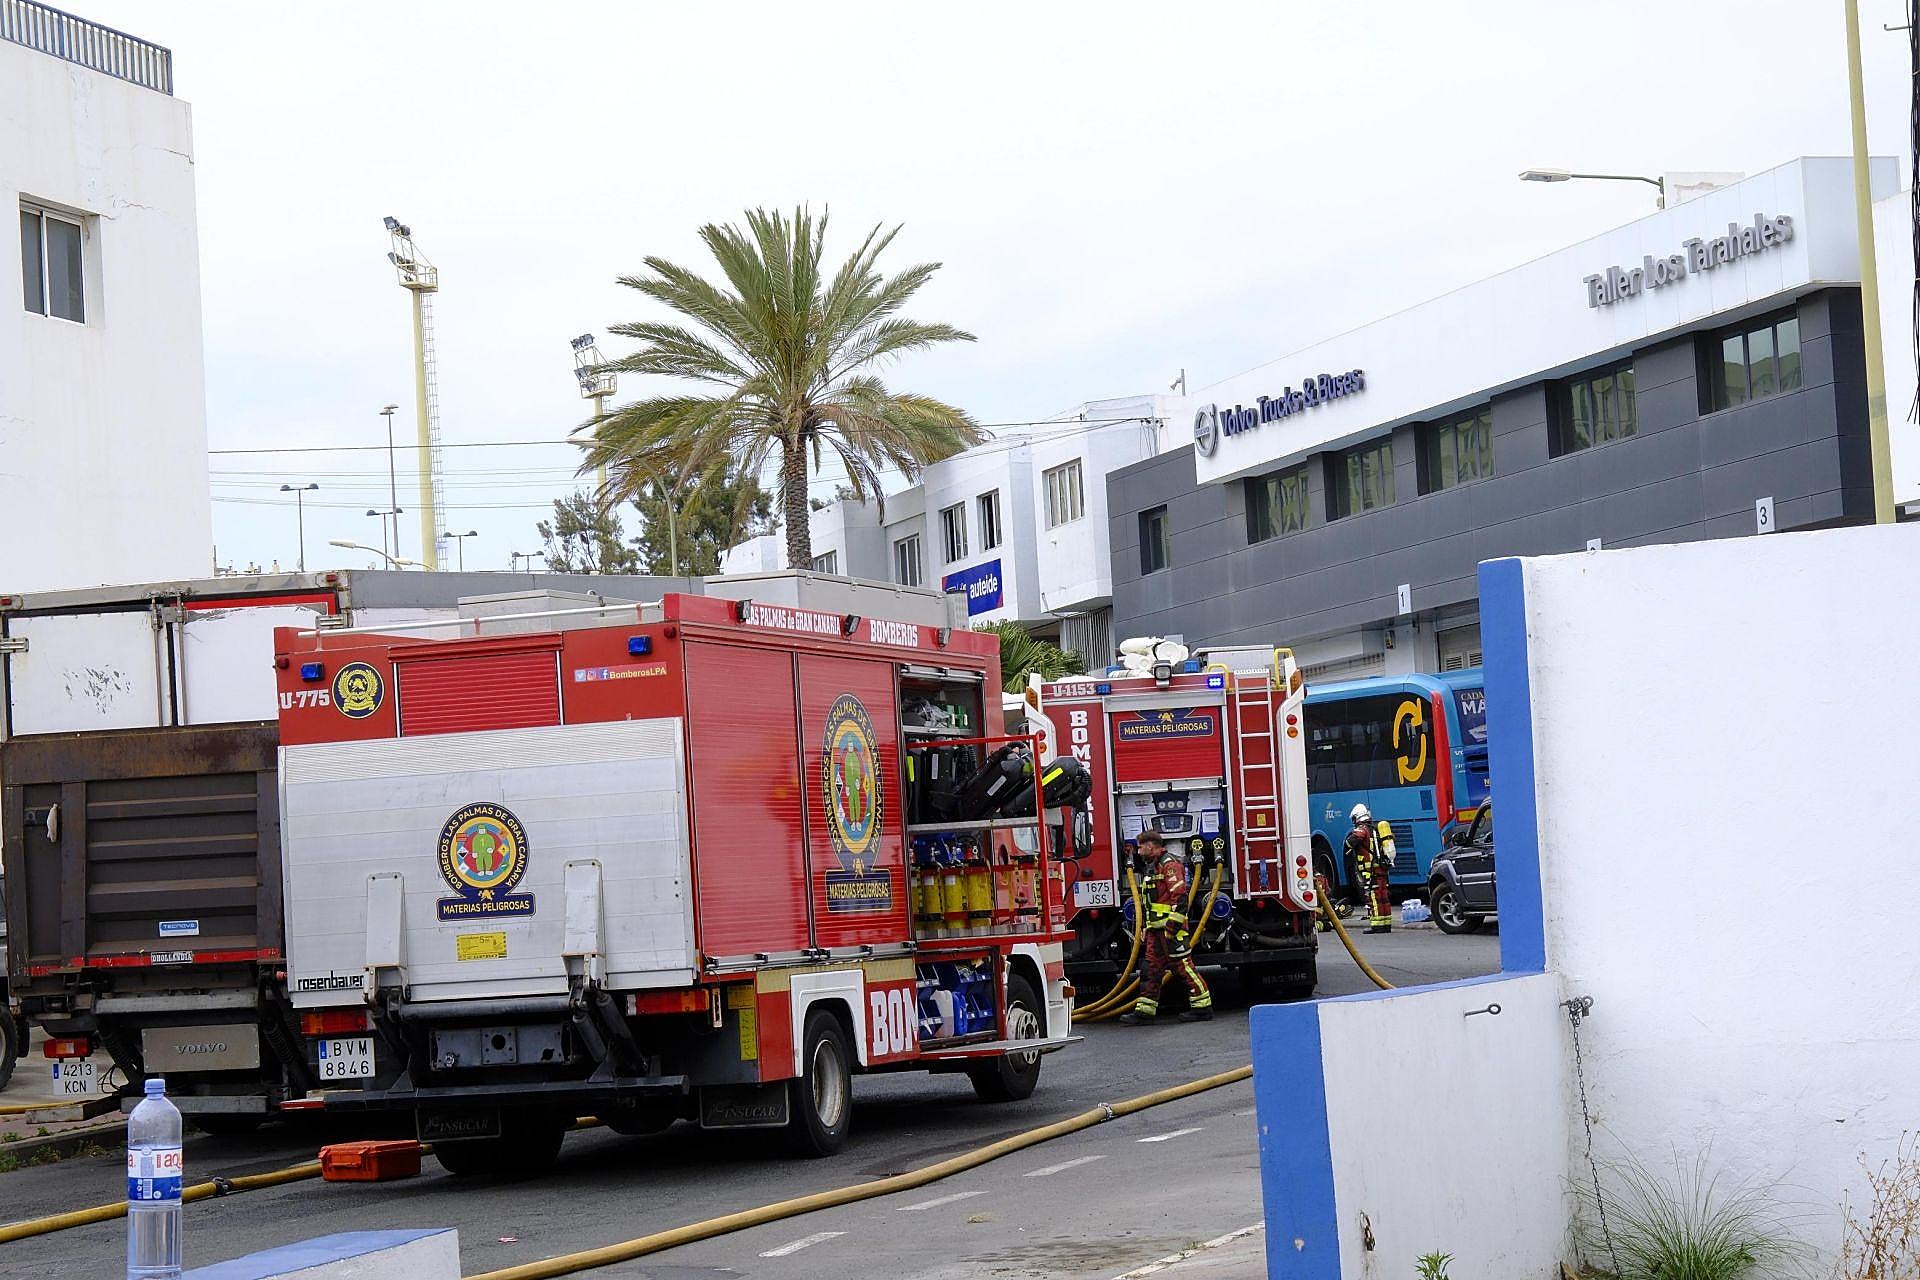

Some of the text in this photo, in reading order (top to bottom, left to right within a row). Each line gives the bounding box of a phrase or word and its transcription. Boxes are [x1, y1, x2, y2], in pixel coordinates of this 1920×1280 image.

[1583, 213, 1793, 308] Taller Los Tarahales
[1220, 369, 1365, 436] Volvo Trucks & Buses
[1759, 506, 1767, 525] 3
[969, 573, 998, 599] auteide
[1400, 591, 1405, 607] 1
[759, 607, 787, 629] PALMAS
[787, 610, 795, 630] de
[795, 611, 813, 632] GRAN
[813, 614, 841, 636] CANARIA
[869, 619, 918, 648] BOMBEROS
[609, 667, 667, 679] BomberosLPA
[1053, 683, 1096, 697] U-1153
[280, 689, 330, 709] U-775
[825, 722, 835, 751] LAS
[833, 701, 857, 723] PALMAS
[1124, 722, 1208, 735] MATERIAS PELIGROSAS
[441, 806, 525, 890] BOMBEROS LAS PALMAS DE GRAN CANARIA
[829, 882, 889, 899] MATERIAS PELIGROSAS
[1085, 882, 1110, 893] 1675
[443, 900, 530, 914] MATERIAS PELIGROSAS
[1088, 894, 1107, 904] JSS
[297, 970, 364, 990] rosenbauer
[176, 1042, 227, 1055] VOLVO
[63, 1063, 92, 1078] 4213
[326, 1060, 369, 1077] 8846
[65, 1081, 87, 1093] KCN
